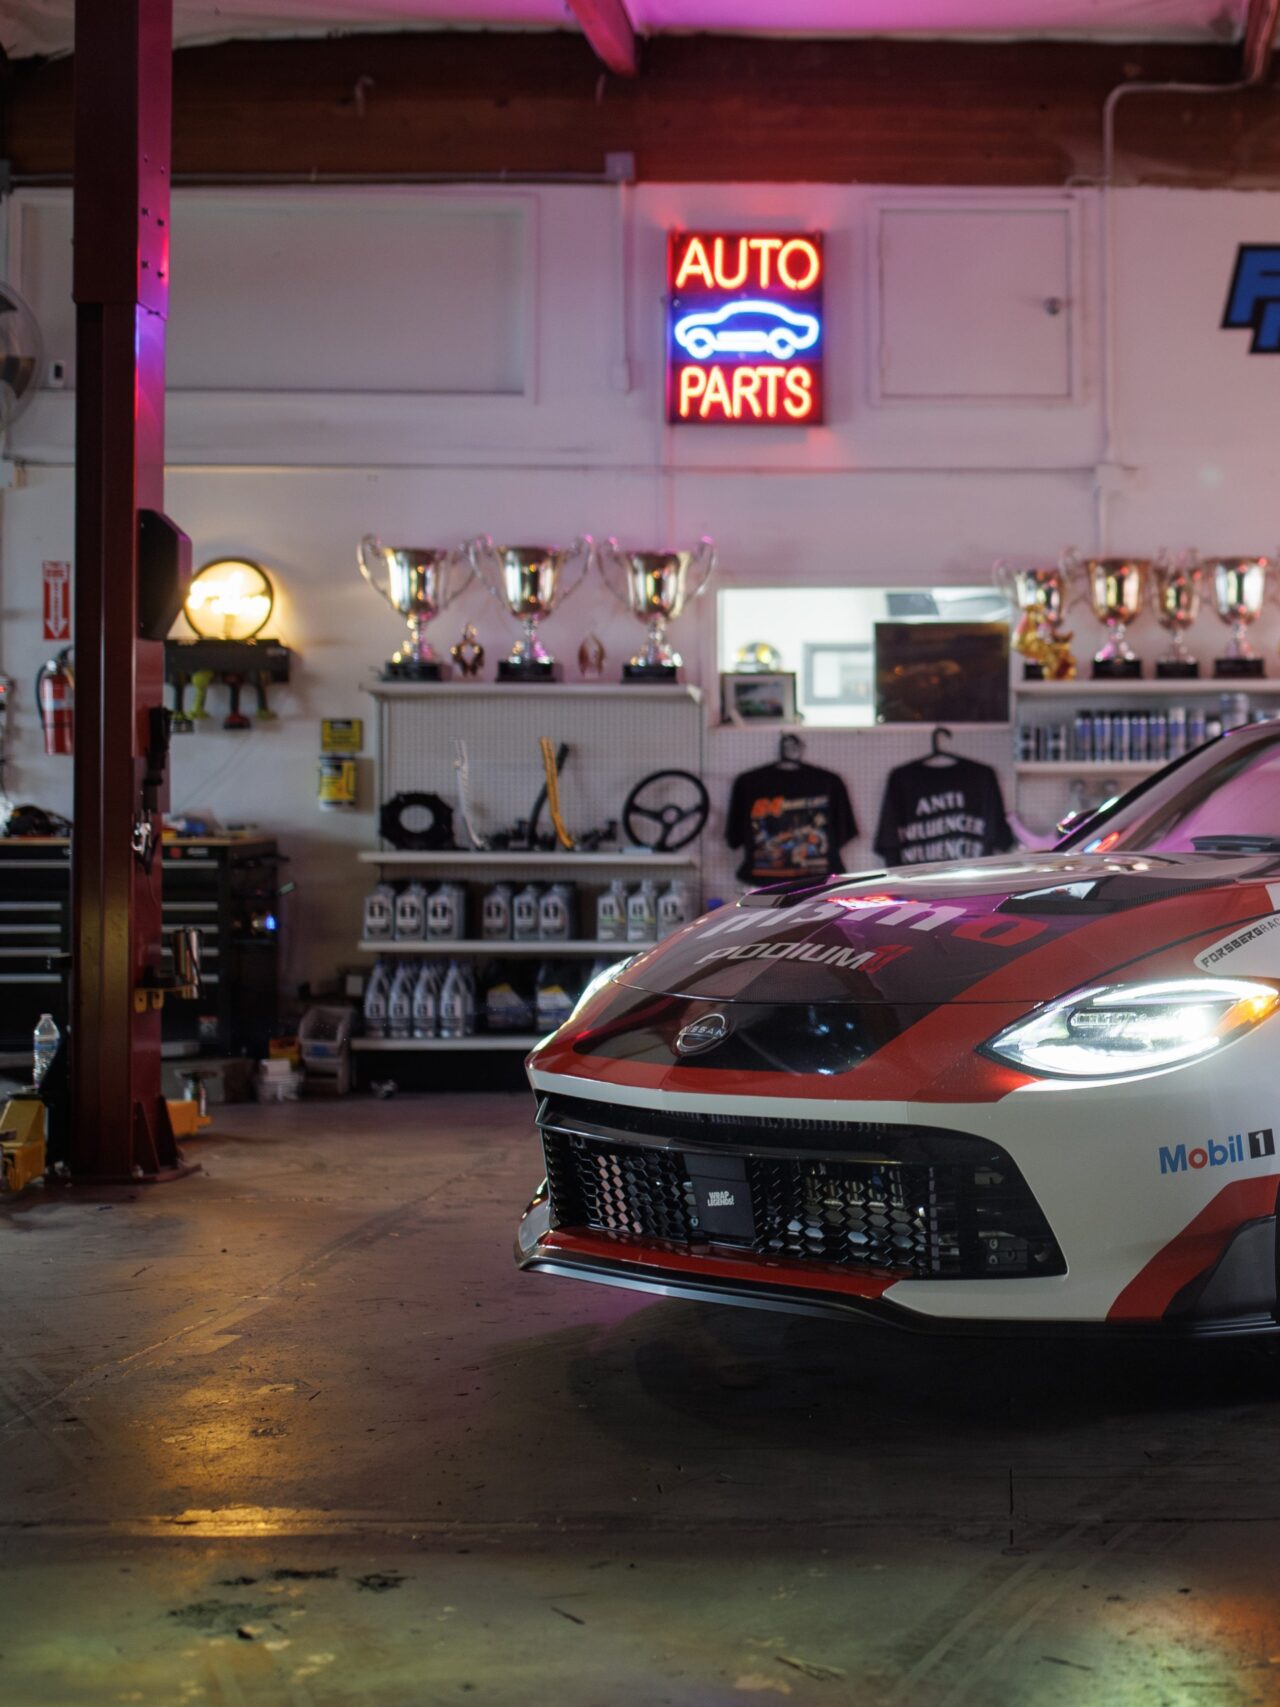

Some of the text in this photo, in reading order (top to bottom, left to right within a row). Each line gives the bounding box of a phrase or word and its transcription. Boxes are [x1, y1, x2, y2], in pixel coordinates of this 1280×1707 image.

[675, 237, 820, 290] AUTO
[679, 365, 812, 418] PARTS
[915, 792, 965, 816] ANTI
[679, 1025, 727, 1038] NISSAN
[1158, 1134, 1245, 1174] Mobil
[708, 1191, 730, 1200] WRAP
